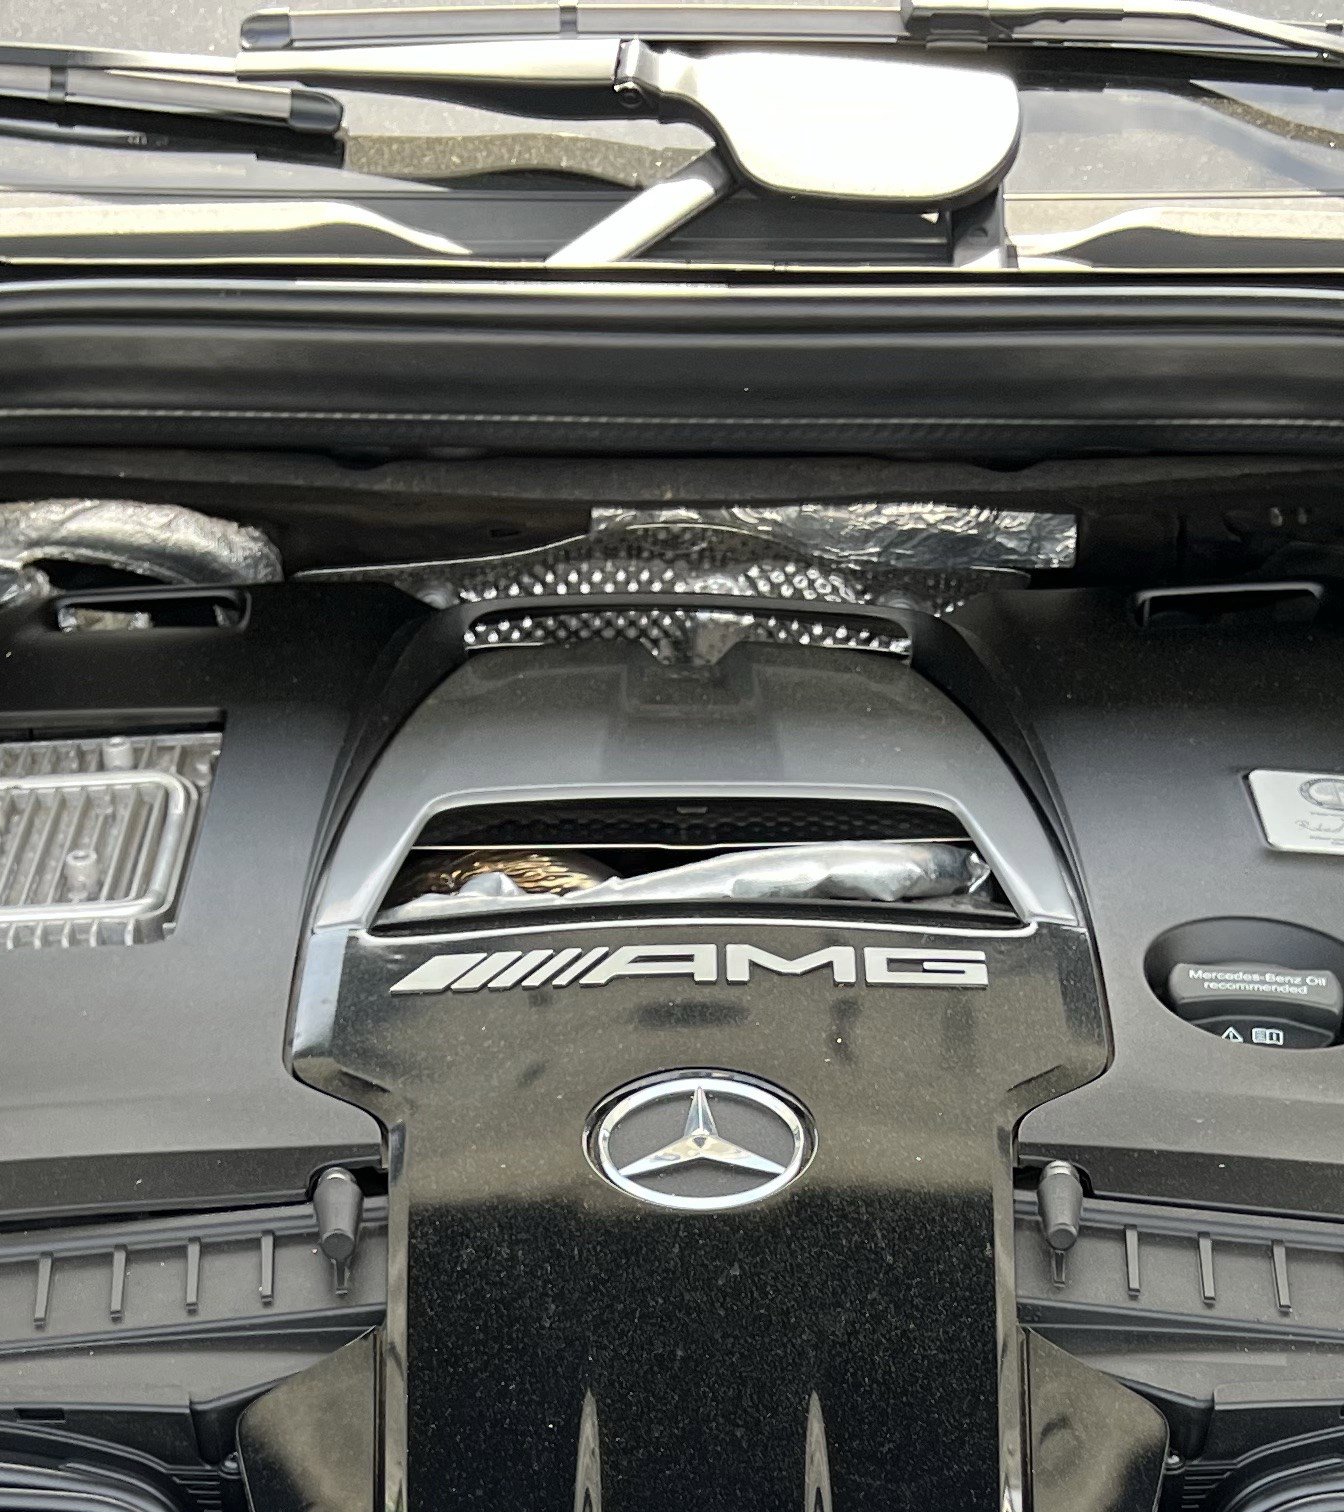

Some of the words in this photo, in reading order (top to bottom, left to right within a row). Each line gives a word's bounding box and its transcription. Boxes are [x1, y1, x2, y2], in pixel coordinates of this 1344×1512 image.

[579, 943, 990, 987] AMG
[1189, 969, 1302, 985] Mercedes-Benz
[1305, 975, 1327, 987] Oil
[1203, 981, 1308, 995] recommended
